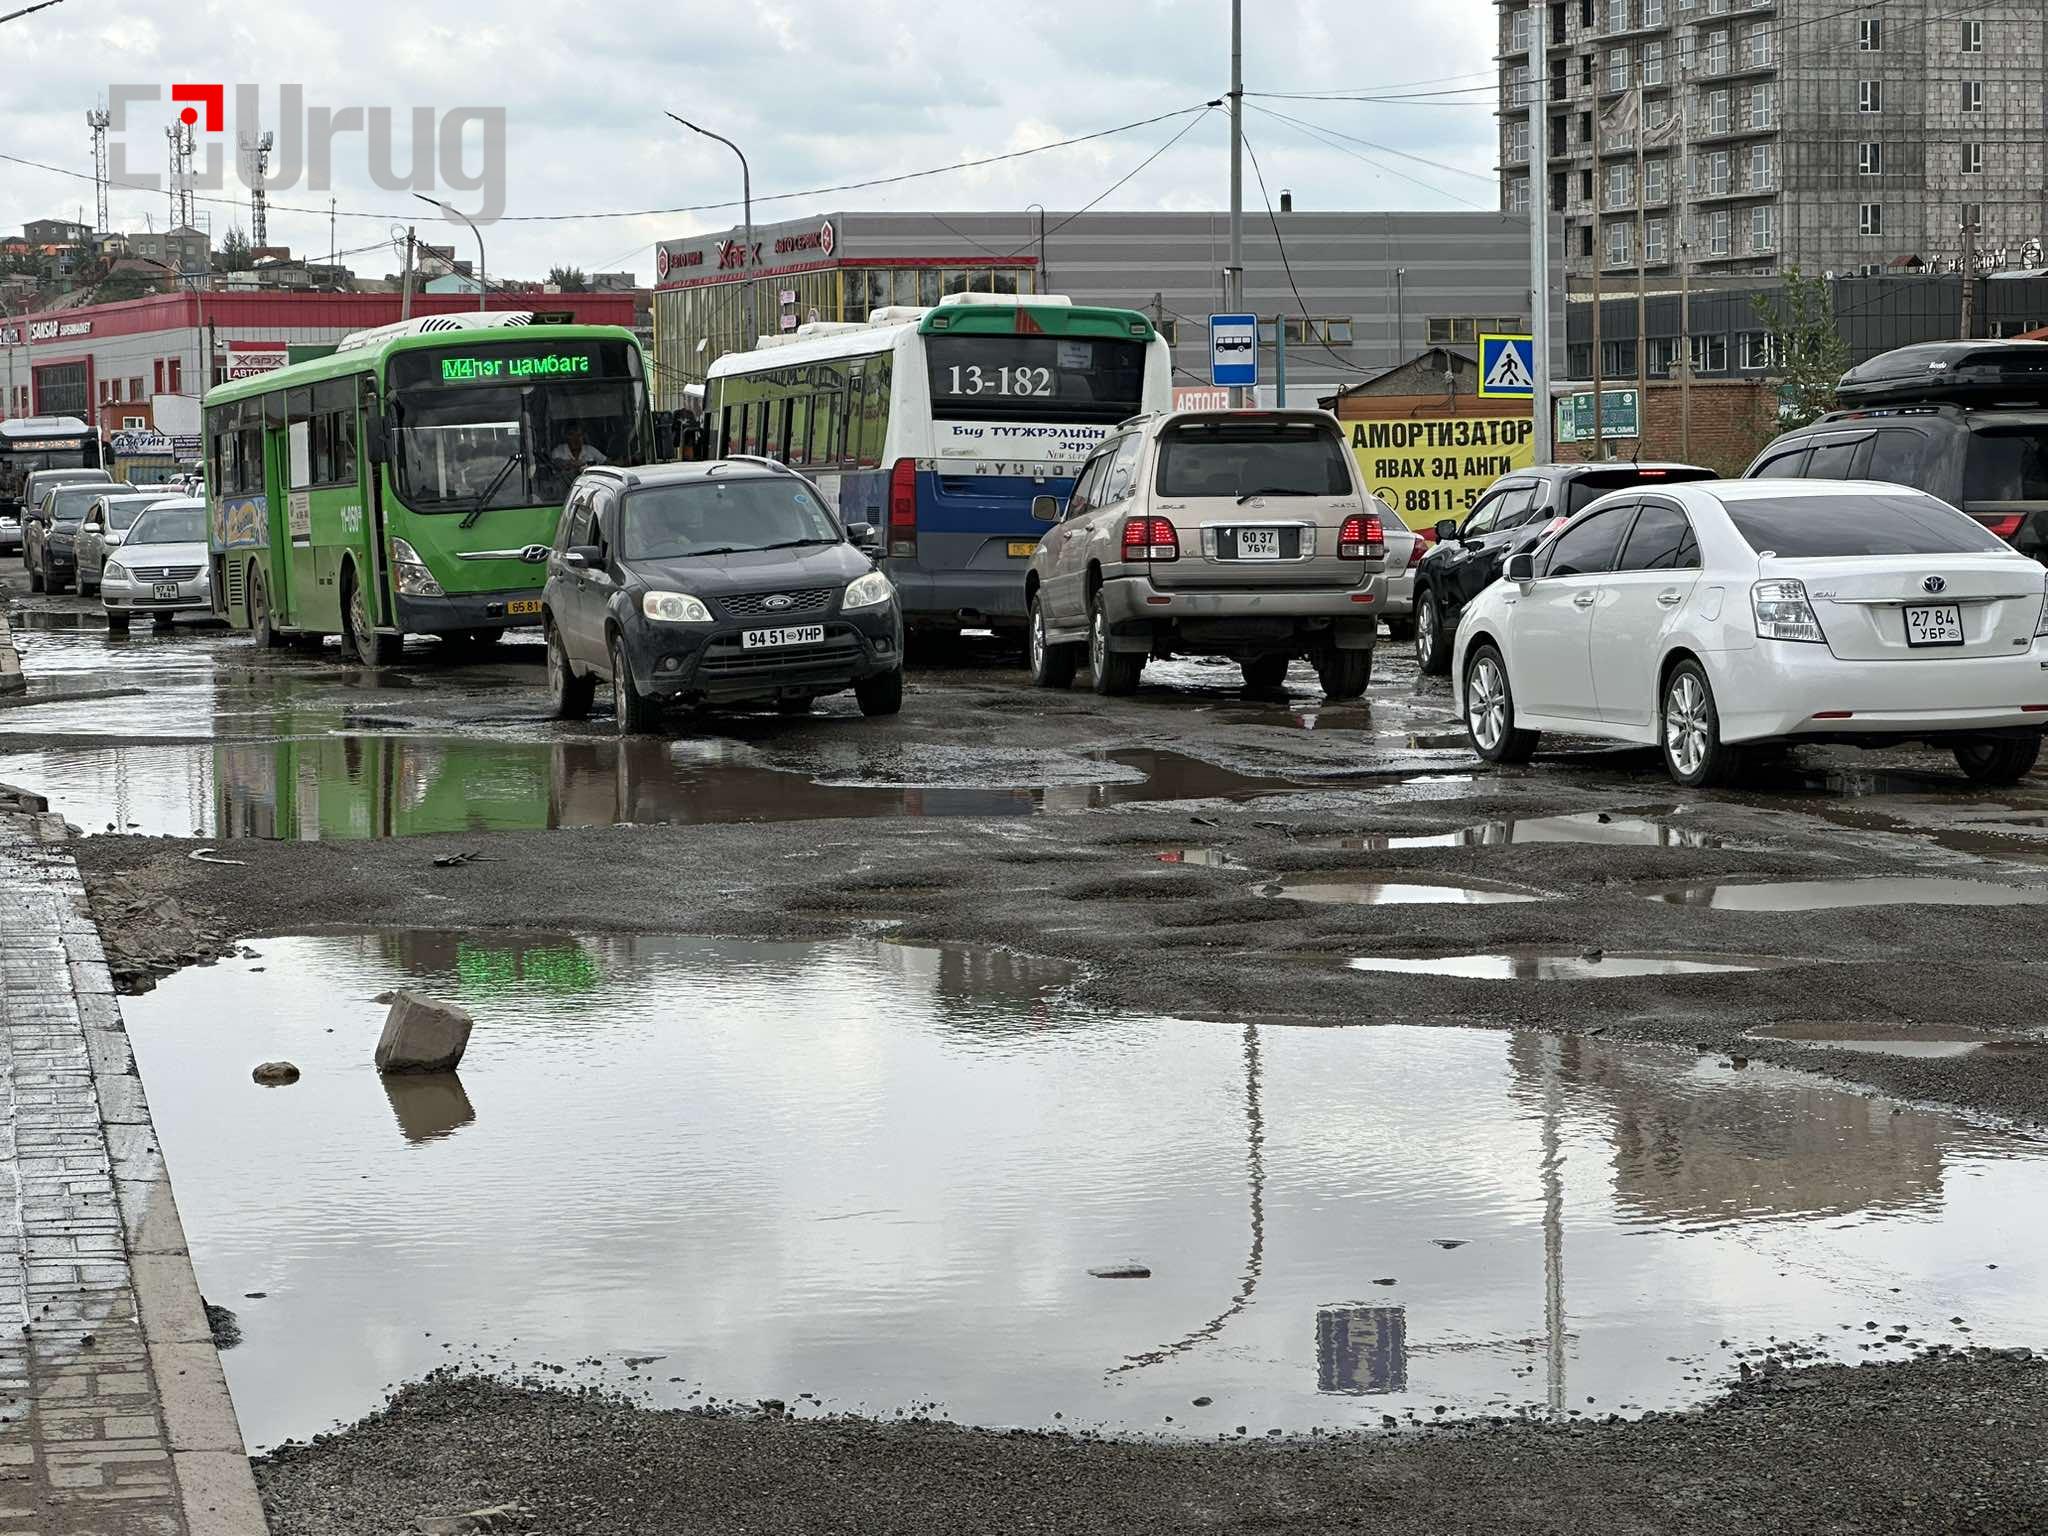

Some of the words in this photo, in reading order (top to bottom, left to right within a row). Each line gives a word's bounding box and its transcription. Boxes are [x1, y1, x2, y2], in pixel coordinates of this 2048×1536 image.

[949, 365, 1051, 396] 13-182
[1352, 419, 1533, 449] АМОРТИЗАТОР
[1059, 441, 1098, 452] эсрэ
[1375, 458, 1425, 478] ЯВАХ
[1431, 457, 1458, 480] ЭД
[1464, 456, 1511, 476] АНГИ
[1242, 531, 1257, 543] 60
[1259, 532, 1274, 543] 37
[1910, 610, 1929, 627] 27
[1935, 609, 1955, 626] 84
[749, 631, 766, 647] 94
[769, 629, 785, 645] 51
[796, 627, 821, 642] УНР
[1919, 627, 1946, 640] УБР
